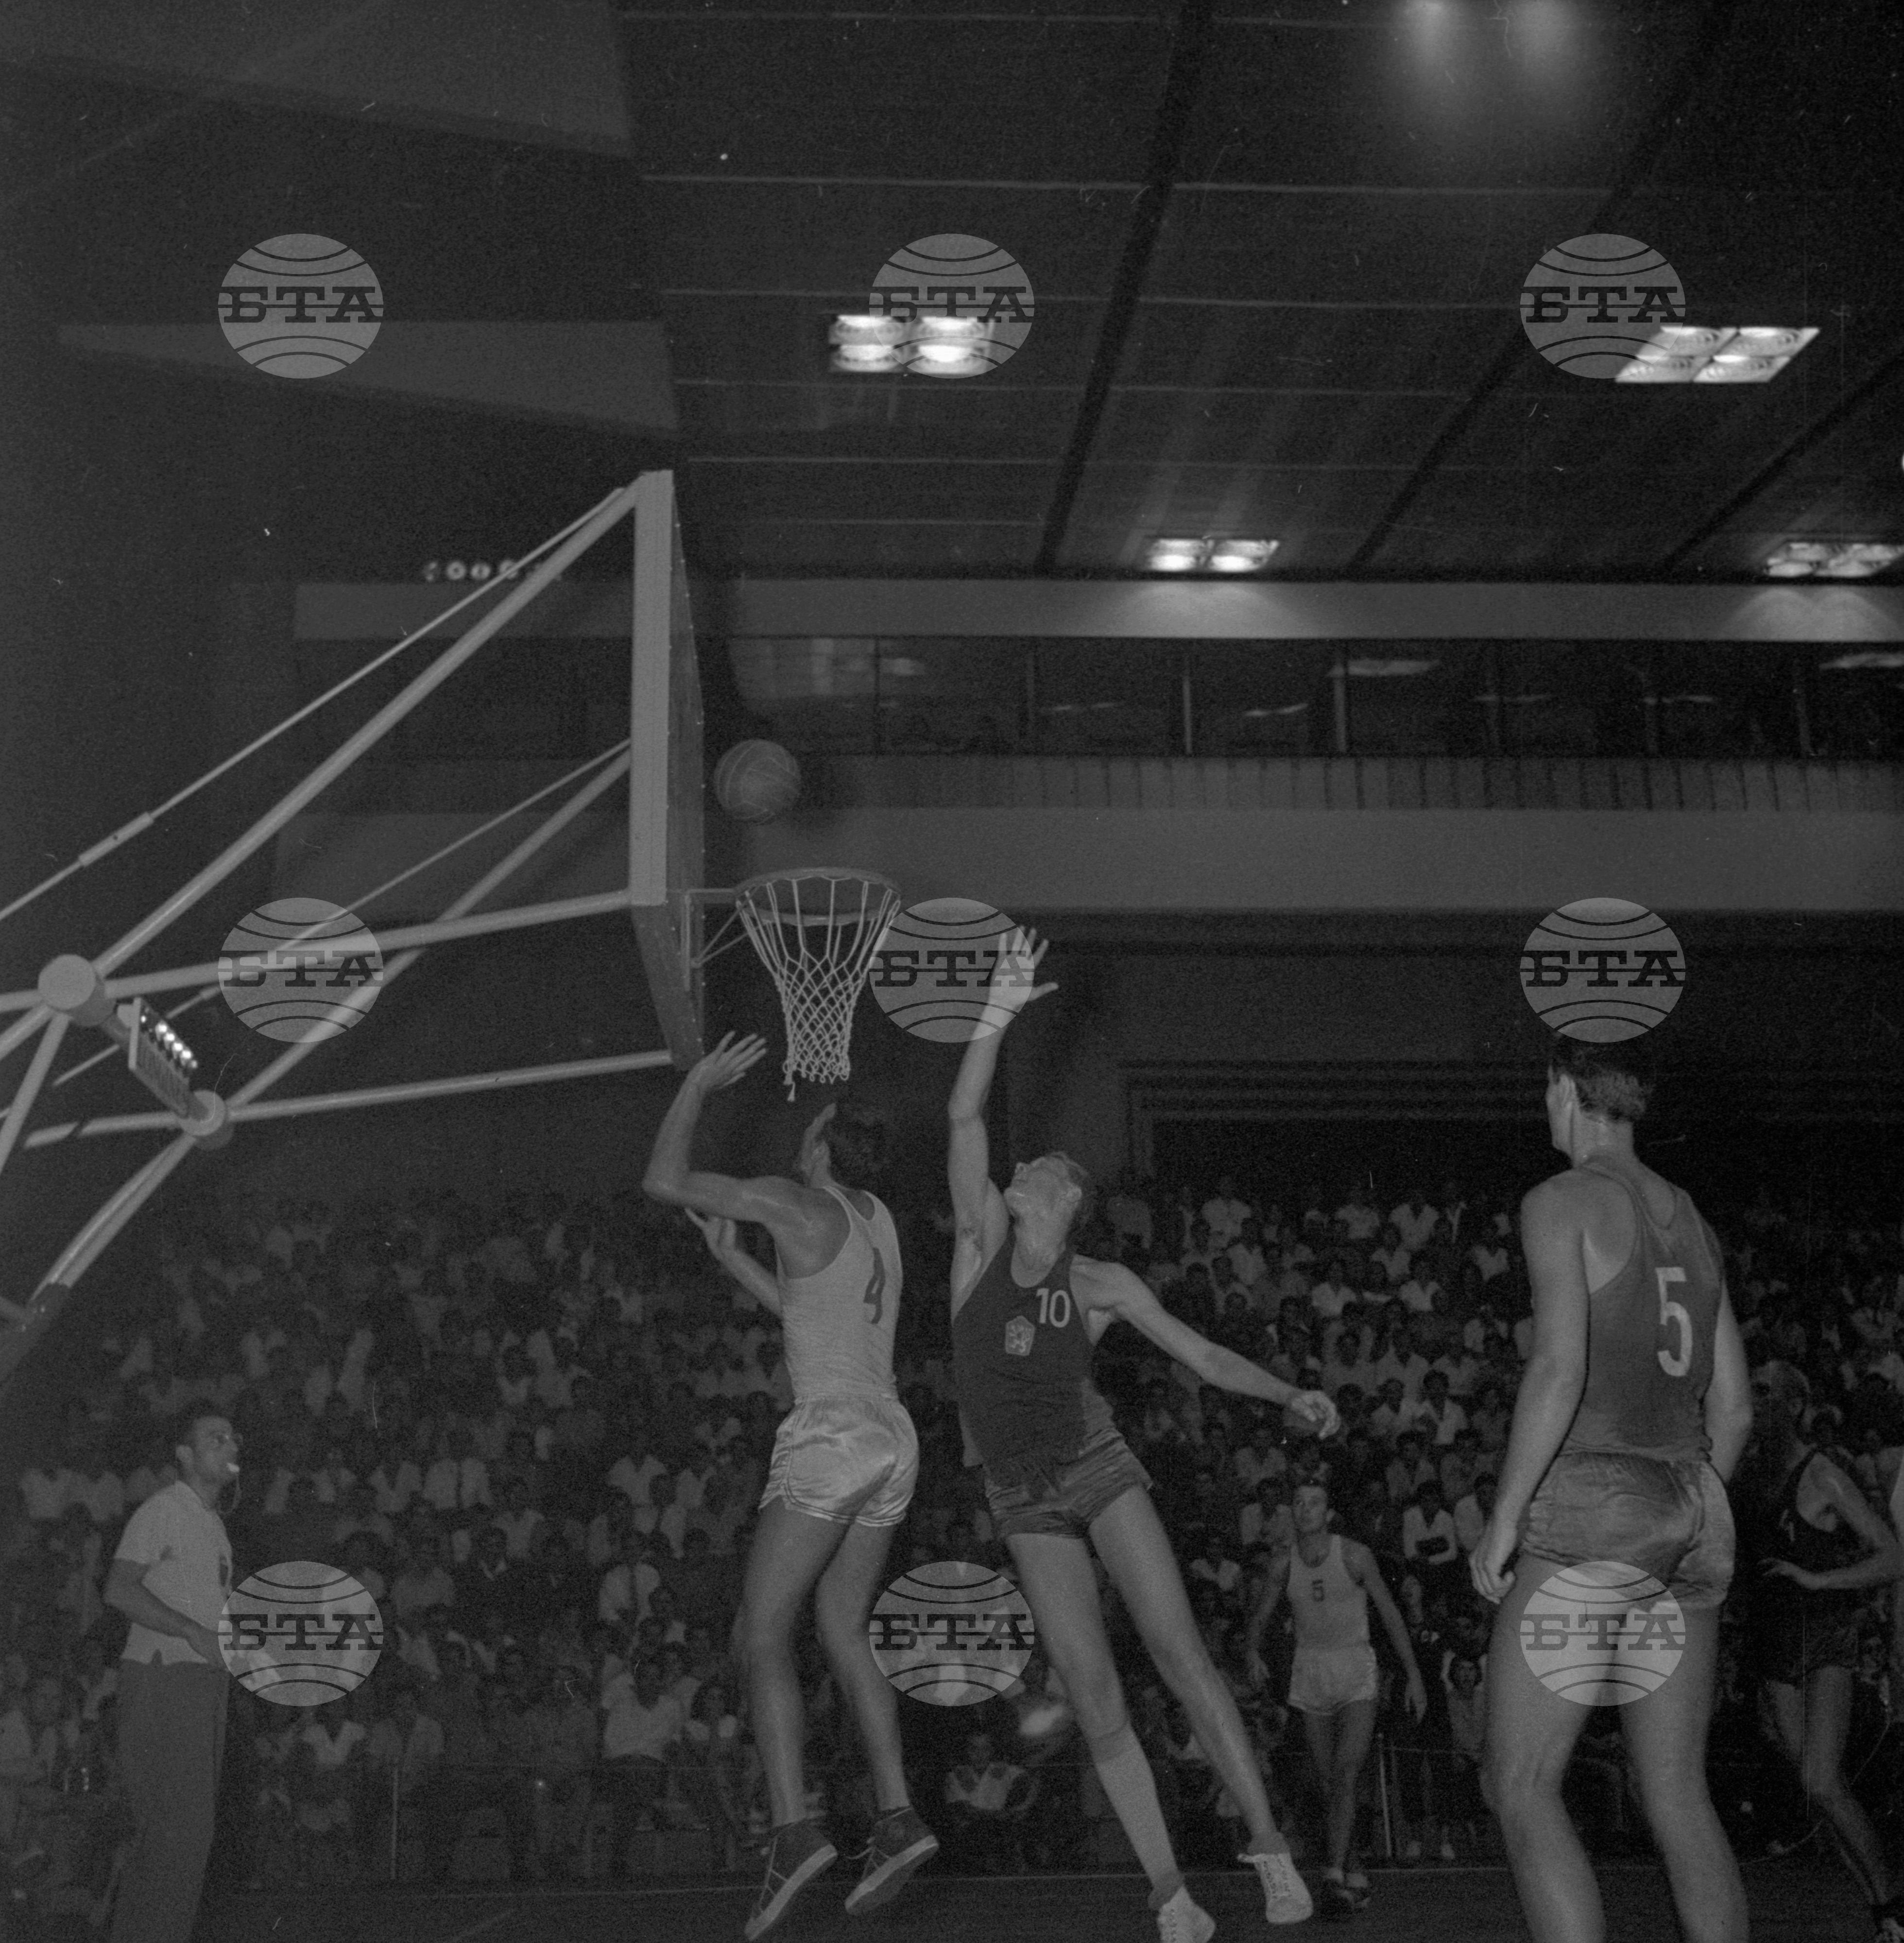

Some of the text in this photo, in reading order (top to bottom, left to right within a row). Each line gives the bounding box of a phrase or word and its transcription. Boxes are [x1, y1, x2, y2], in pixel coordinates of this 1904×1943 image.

[1036, 1288, 1070, 1328] 10
[1655, 1267, 1693, 1377] 5
[1312, 1580, 1324, 1602] 5
